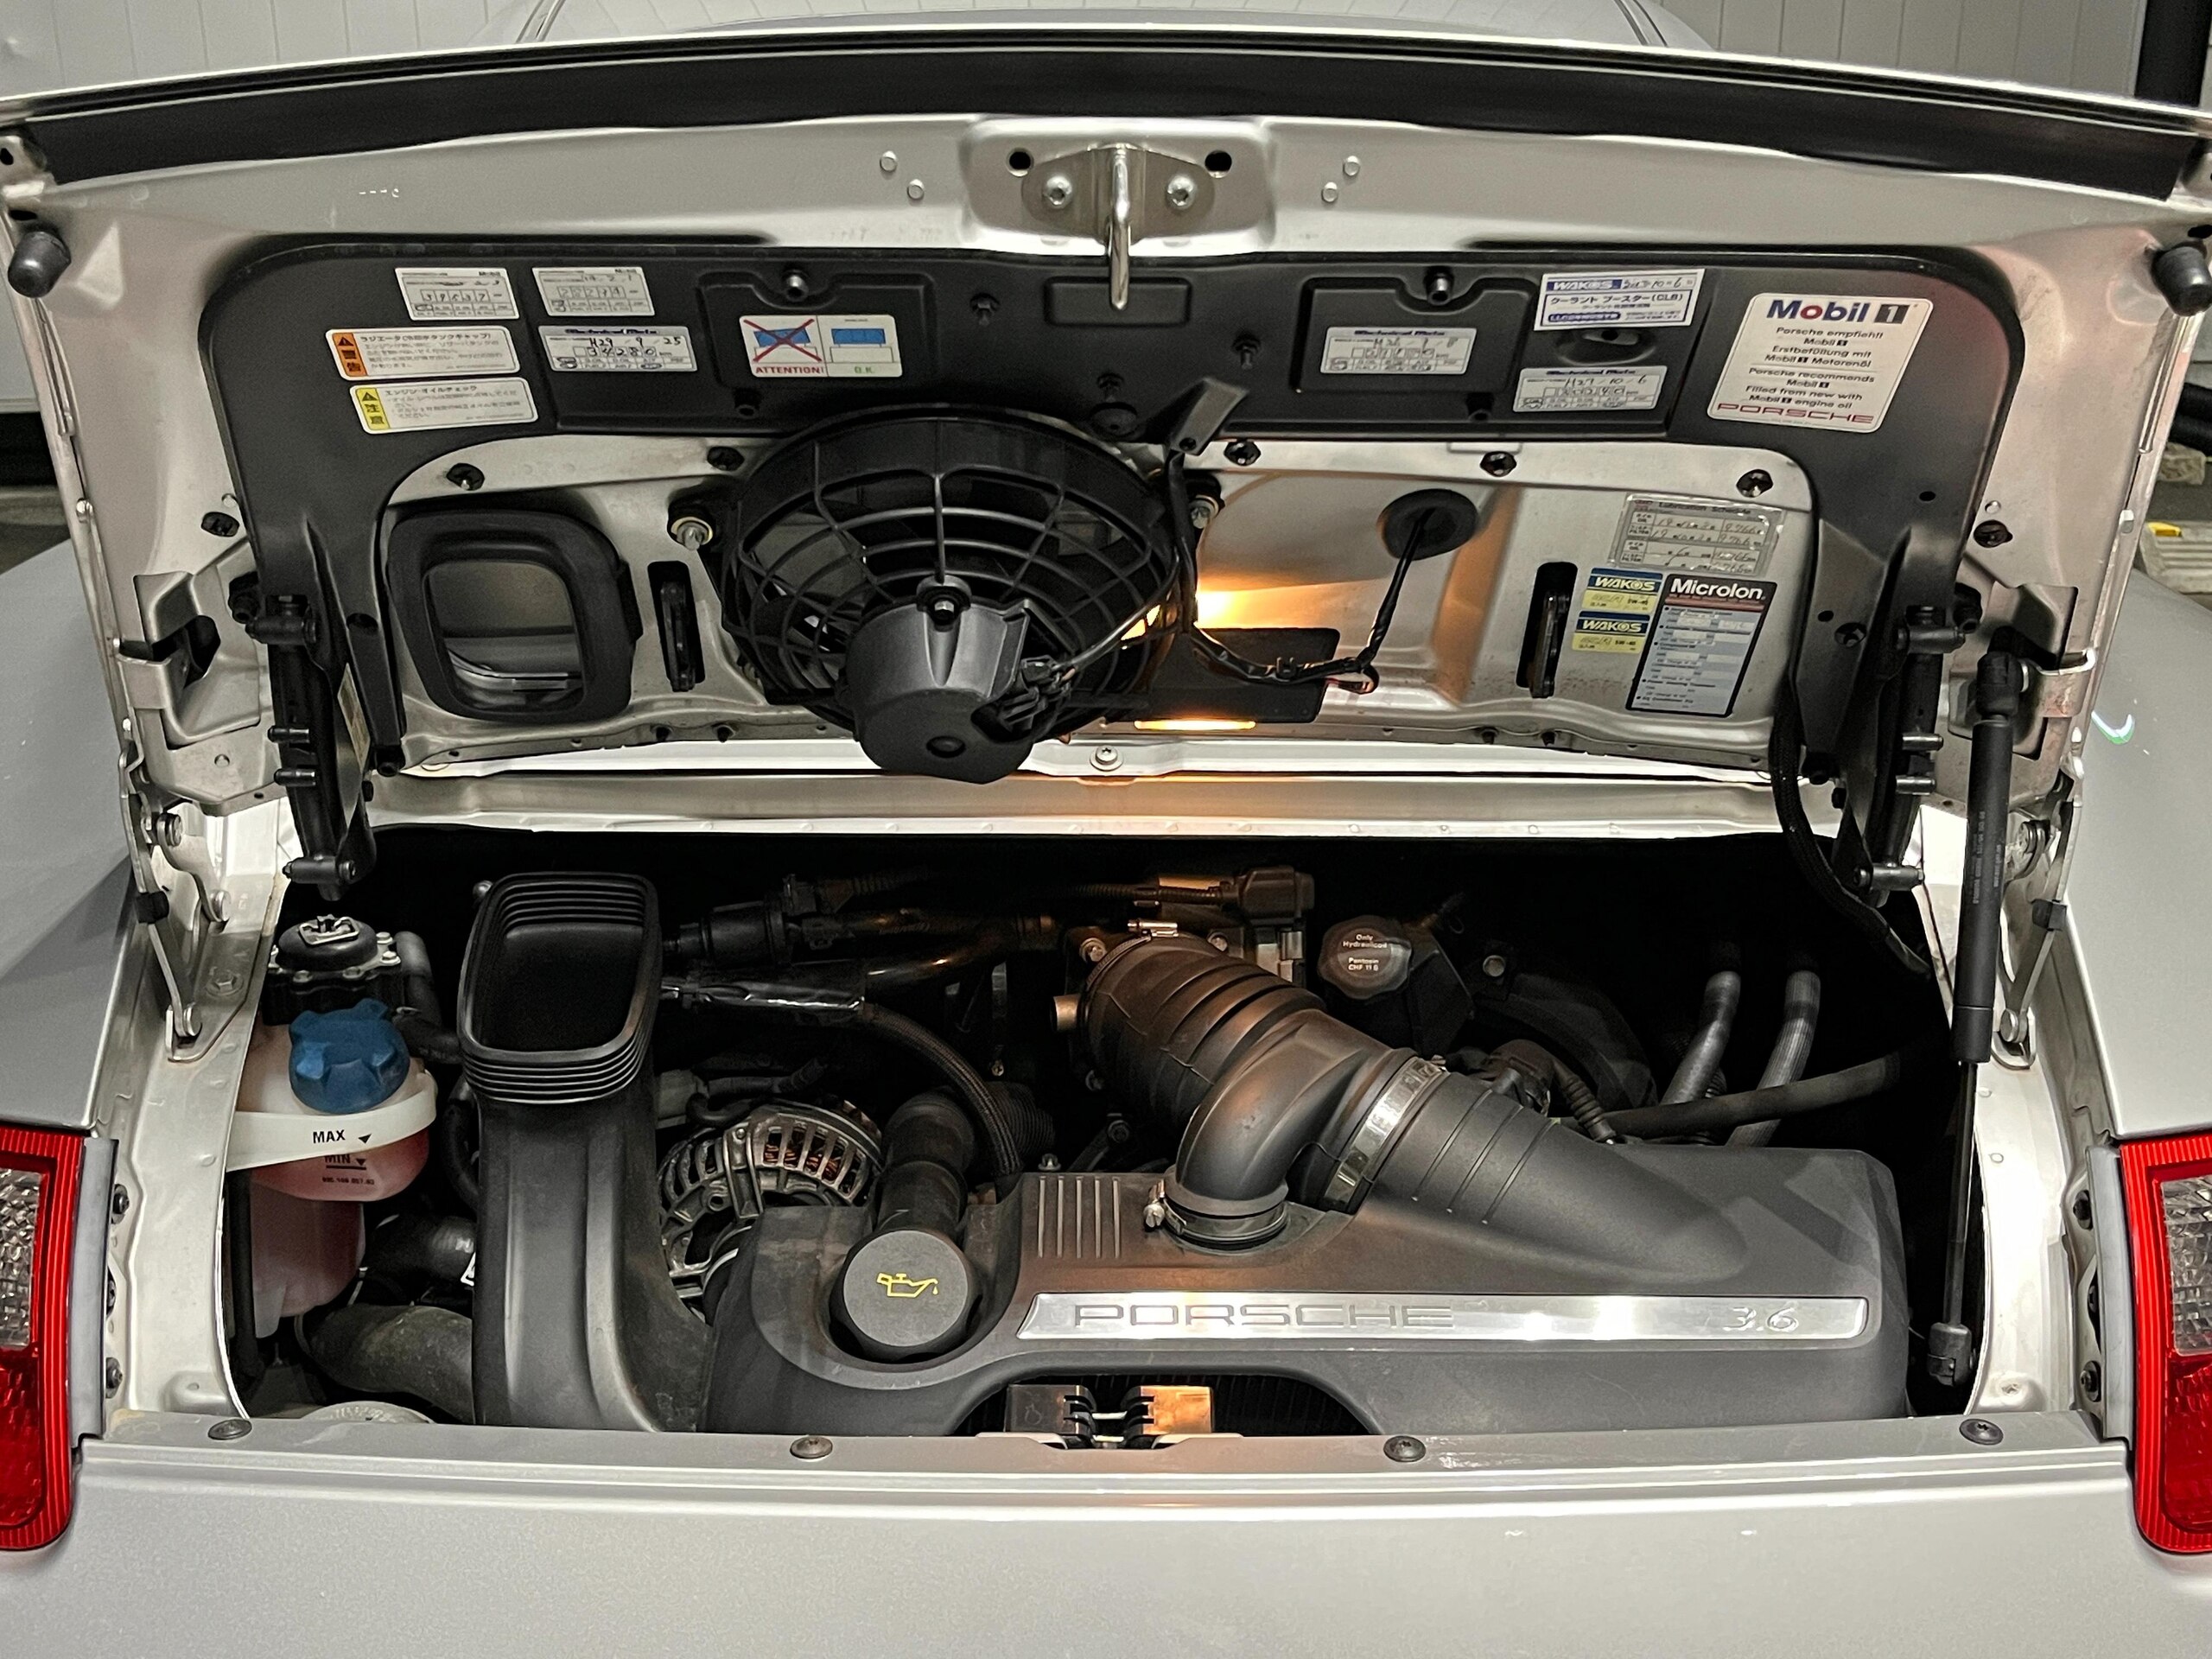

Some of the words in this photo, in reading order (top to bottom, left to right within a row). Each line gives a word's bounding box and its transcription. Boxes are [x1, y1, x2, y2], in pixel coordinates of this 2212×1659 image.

[1766, 299, 1870, 323] Mobil
[1776, 327, 1824, 336] Porsche
[1827, 330, 1884, 340] empfiehlt
[663, 337, 682, 346] 25
[1803, 338, 1836, 346] Mobil
[1764, 354, 1797, 364] Mobil
[1852, 350, 1872, 359] mit
[1811, 357, 1872, 368] Motorenöl
[1748, 367, 1796, 378] Porsche
[1797, 371, 1876, 383] recommends
[1786, 378, 1819, 388] Mobil
[1745, 385, 1777, 394] Filled
[1779, 387, 1808, 396] from
[1837, 392, 1864, 401] with
[1748, 394, 1782, 404] Mobil
[1794, 398, 1835, 409] engine
[1716, 403, 1875, 424] PORSCHE
[1670, 577, 1764, 600] Microlon
[313, 1128, 346, 1144] MAX
[324, 1154, 351, 1164] MIN
[1073, 1303, 1454, 1328] PORSCHE
[1722, 1305, 1800, 1332] 3.6
